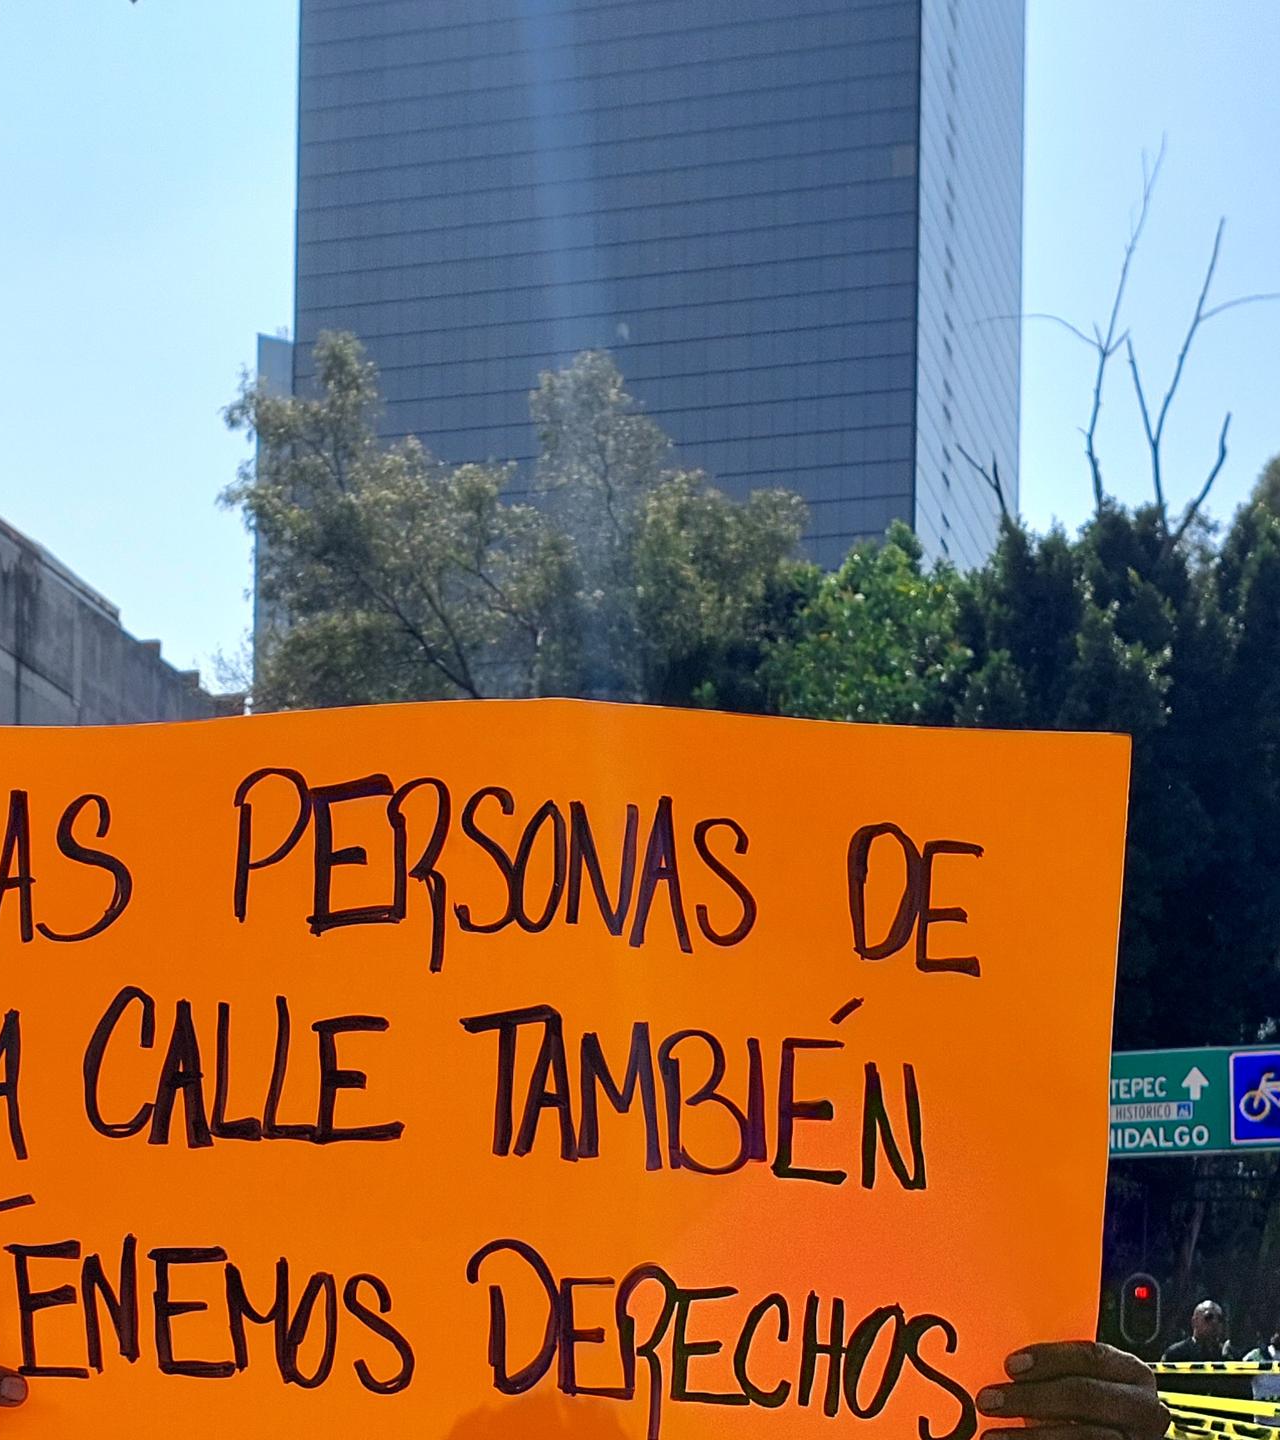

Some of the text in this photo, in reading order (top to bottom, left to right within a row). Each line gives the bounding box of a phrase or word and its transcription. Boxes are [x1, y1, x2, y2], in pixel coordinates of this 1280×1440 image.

[233, 767, 757, 974] PERSONAS
[847, 822, 984, 978] DE
[82, 985, 405, 1149] CALLE
[459, 998, 927, 1191] TAMBIÉN
